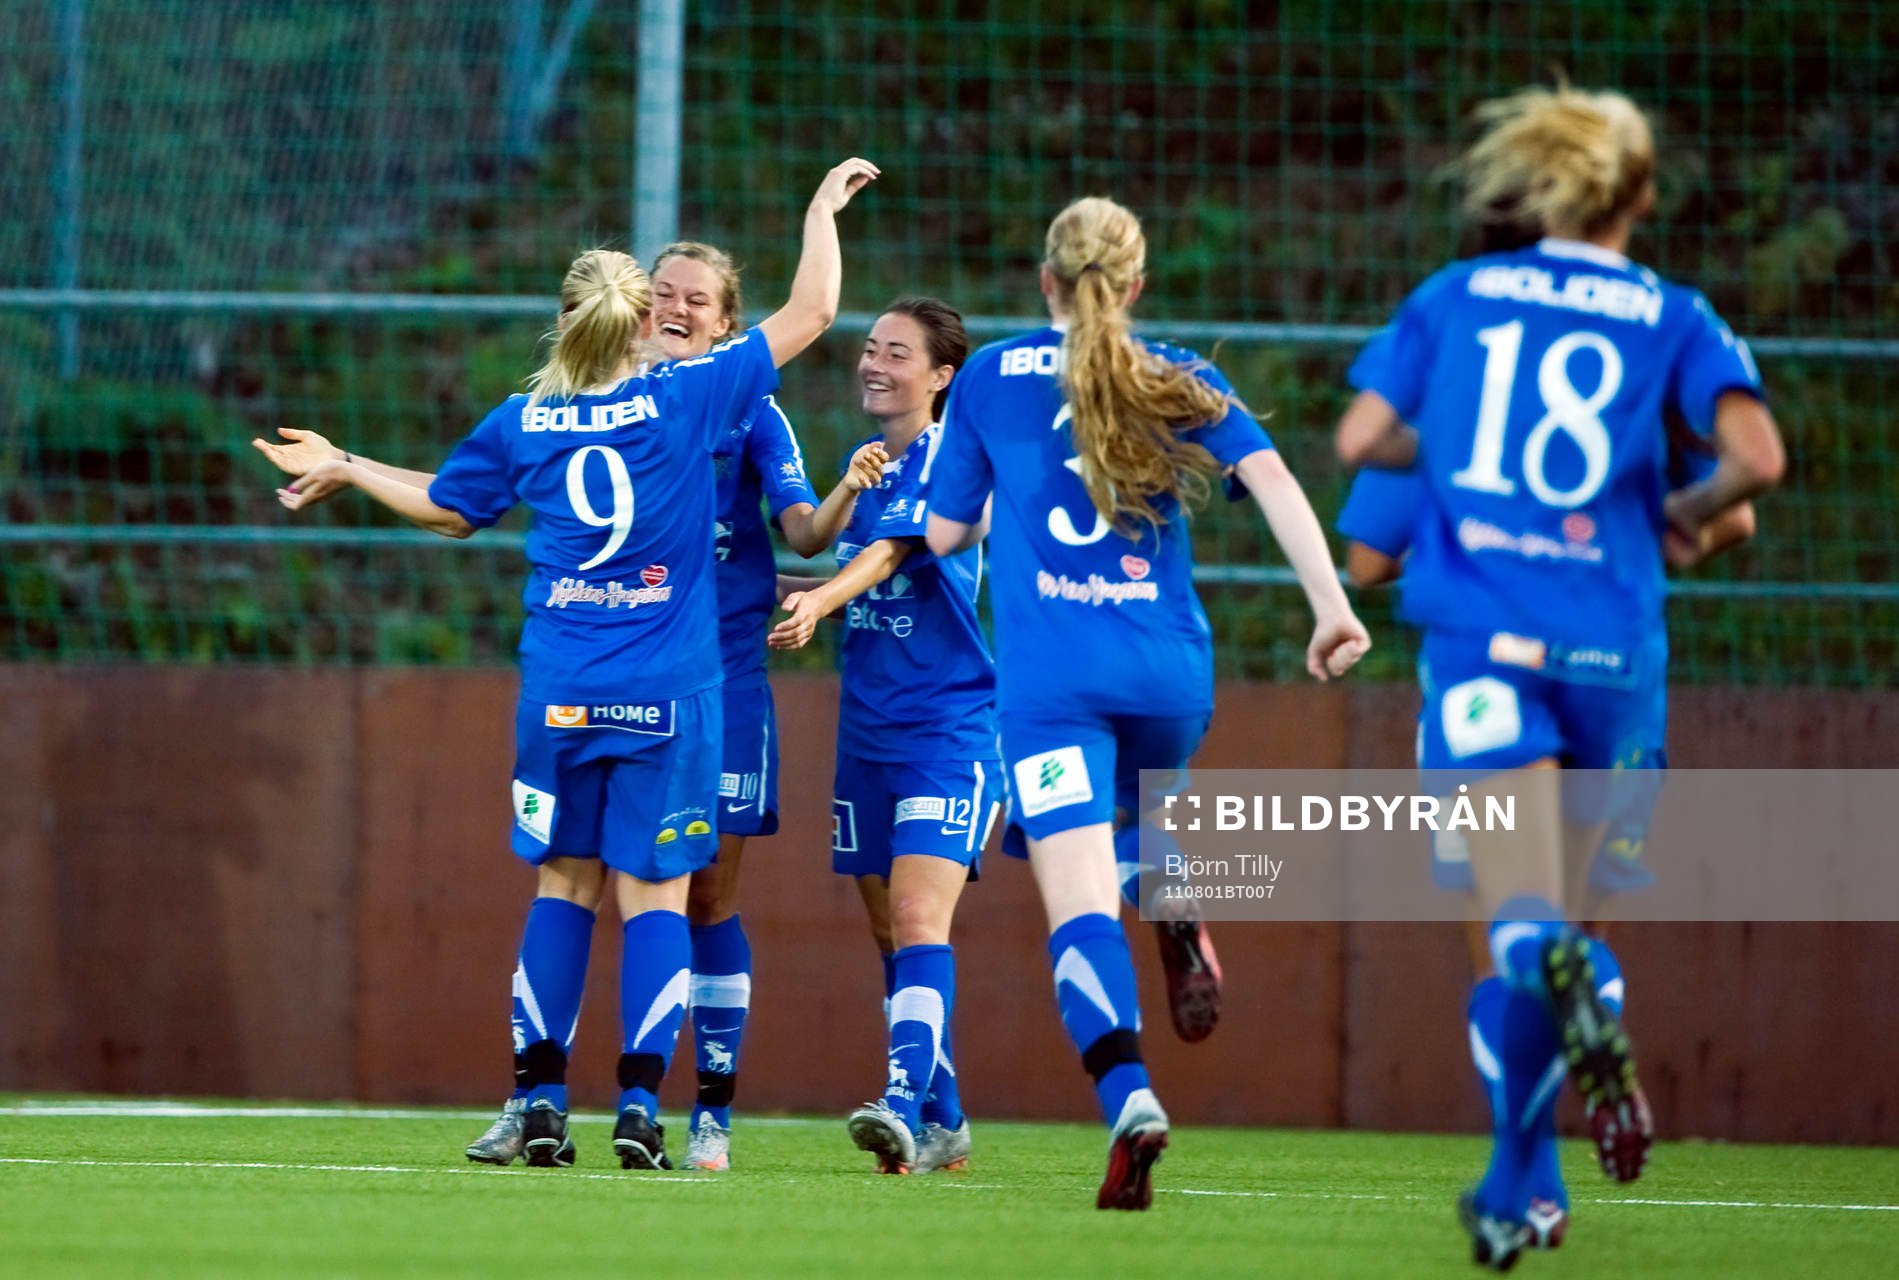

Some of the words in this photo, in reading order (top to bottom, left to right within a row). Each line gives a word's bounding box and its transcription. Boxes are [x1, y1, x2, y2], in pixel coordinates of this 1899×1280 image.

[527, 395, 660, 432] BOLIDEN
[1452, 319, 1623, 508] 18
[566, 445, 635, 571] 9
[740, 772, 759, 800] 10
[944, 797, 971, 827] 12
